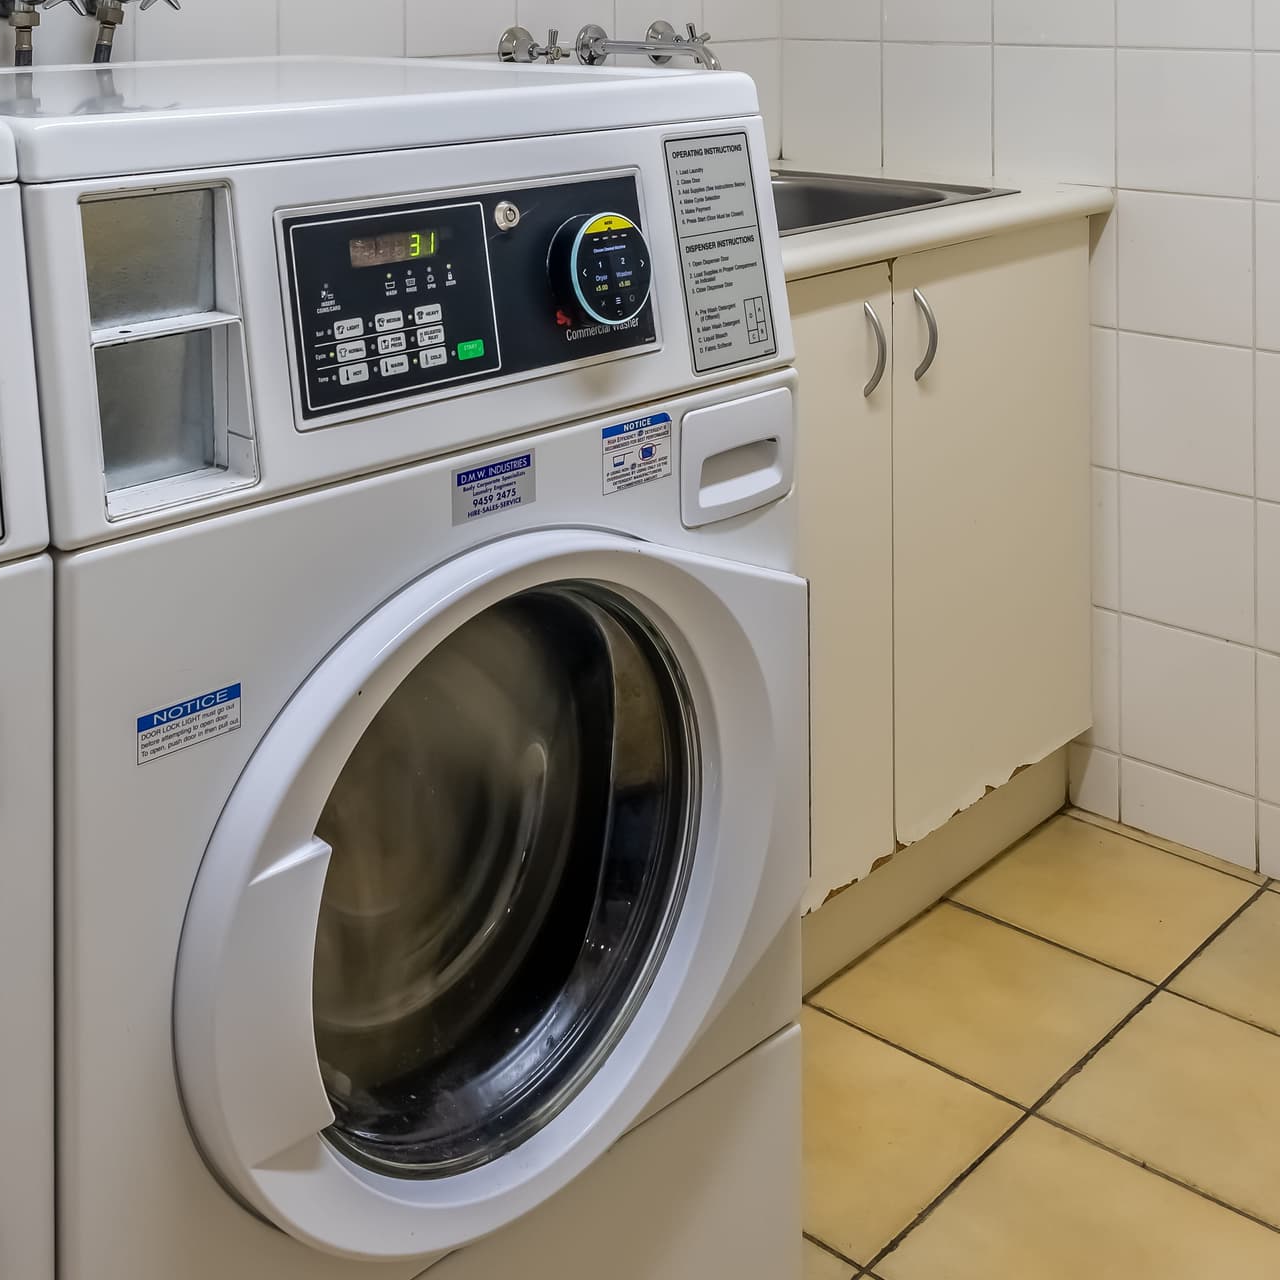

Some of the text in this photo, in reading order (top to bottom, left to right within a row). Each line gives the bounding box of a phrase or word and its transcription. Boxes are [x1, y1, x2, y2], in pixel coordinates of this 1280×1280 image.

[672, 144, 742, 159] OPERATING INSTRUCTIONS
[686, 234, 755, 253] DISPENSER INSTRUCTIONS
[624, 417, 652, 432] NOTICE
[461, 458, 528, 484] D.M.W. INDUSTRIES
[472, 487, 517, 508] 9459 2475
[153, 689, 229, 725] NOTICE
